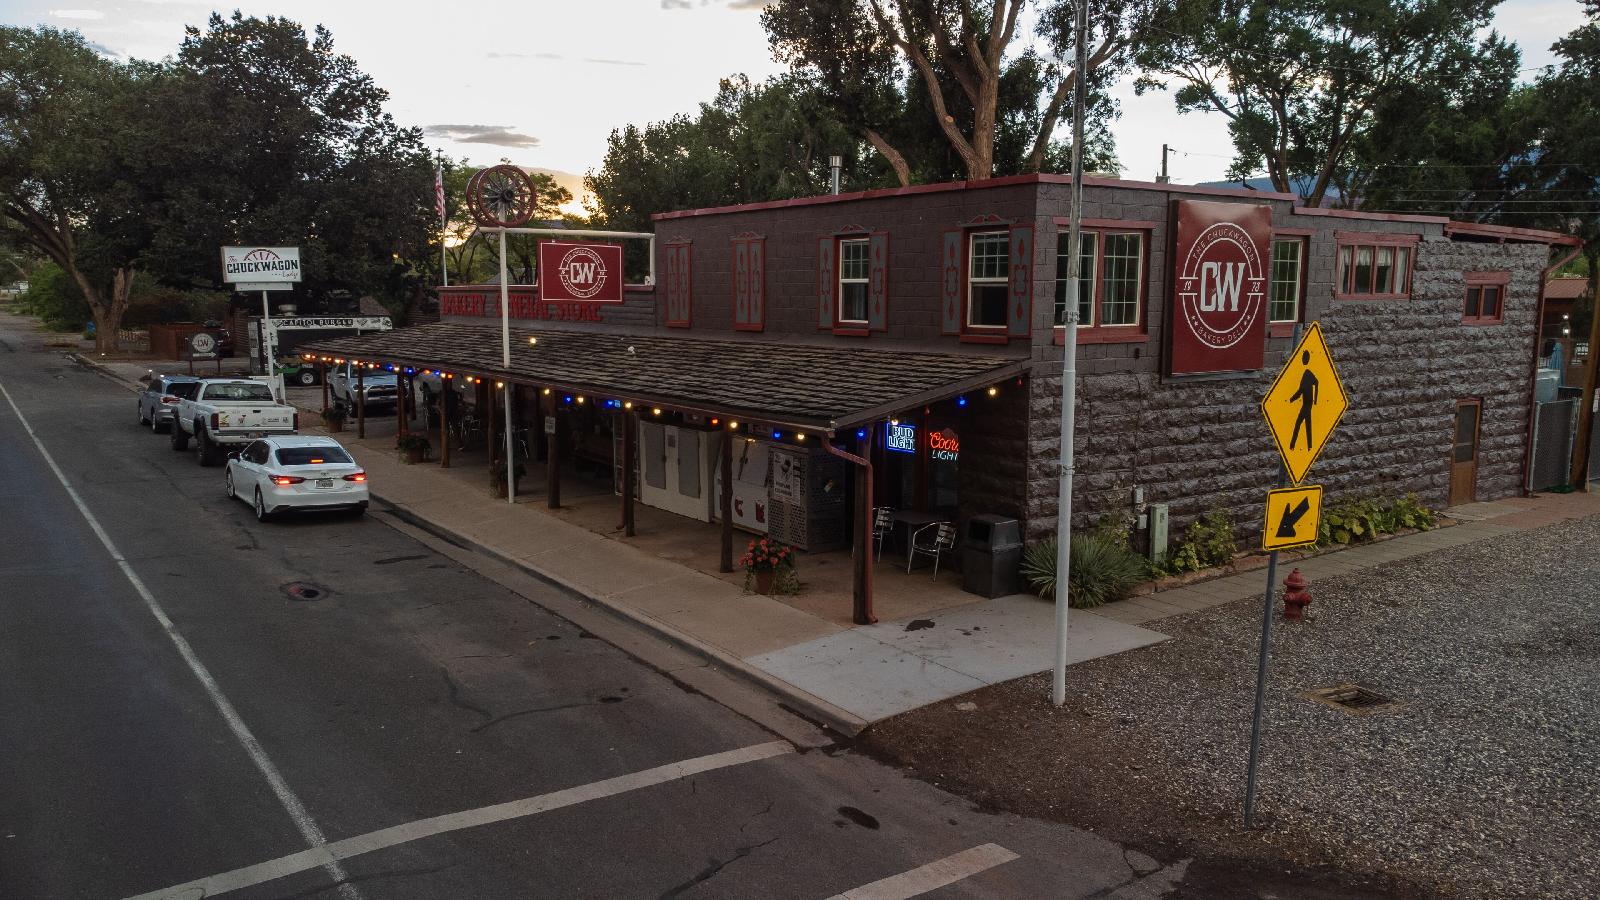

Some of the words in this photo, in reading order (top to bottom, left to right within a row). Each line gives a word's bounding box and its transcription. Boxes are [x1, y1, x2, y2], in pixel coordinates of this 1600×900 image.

[1192, 240, 1206, 260] THE
[1207, 228, 1254, 262] CHUCKWAGON
[227, 259, 299, 274] CHUCKWAGON
[570, 262, 595, 284] CW
[1200, 261, 1247, 312] CW
[441, 294, 487, 316] BAKERY
[1197, 326, 1225, 344] BAKERY
[893, 426, 914, 438] BUD
